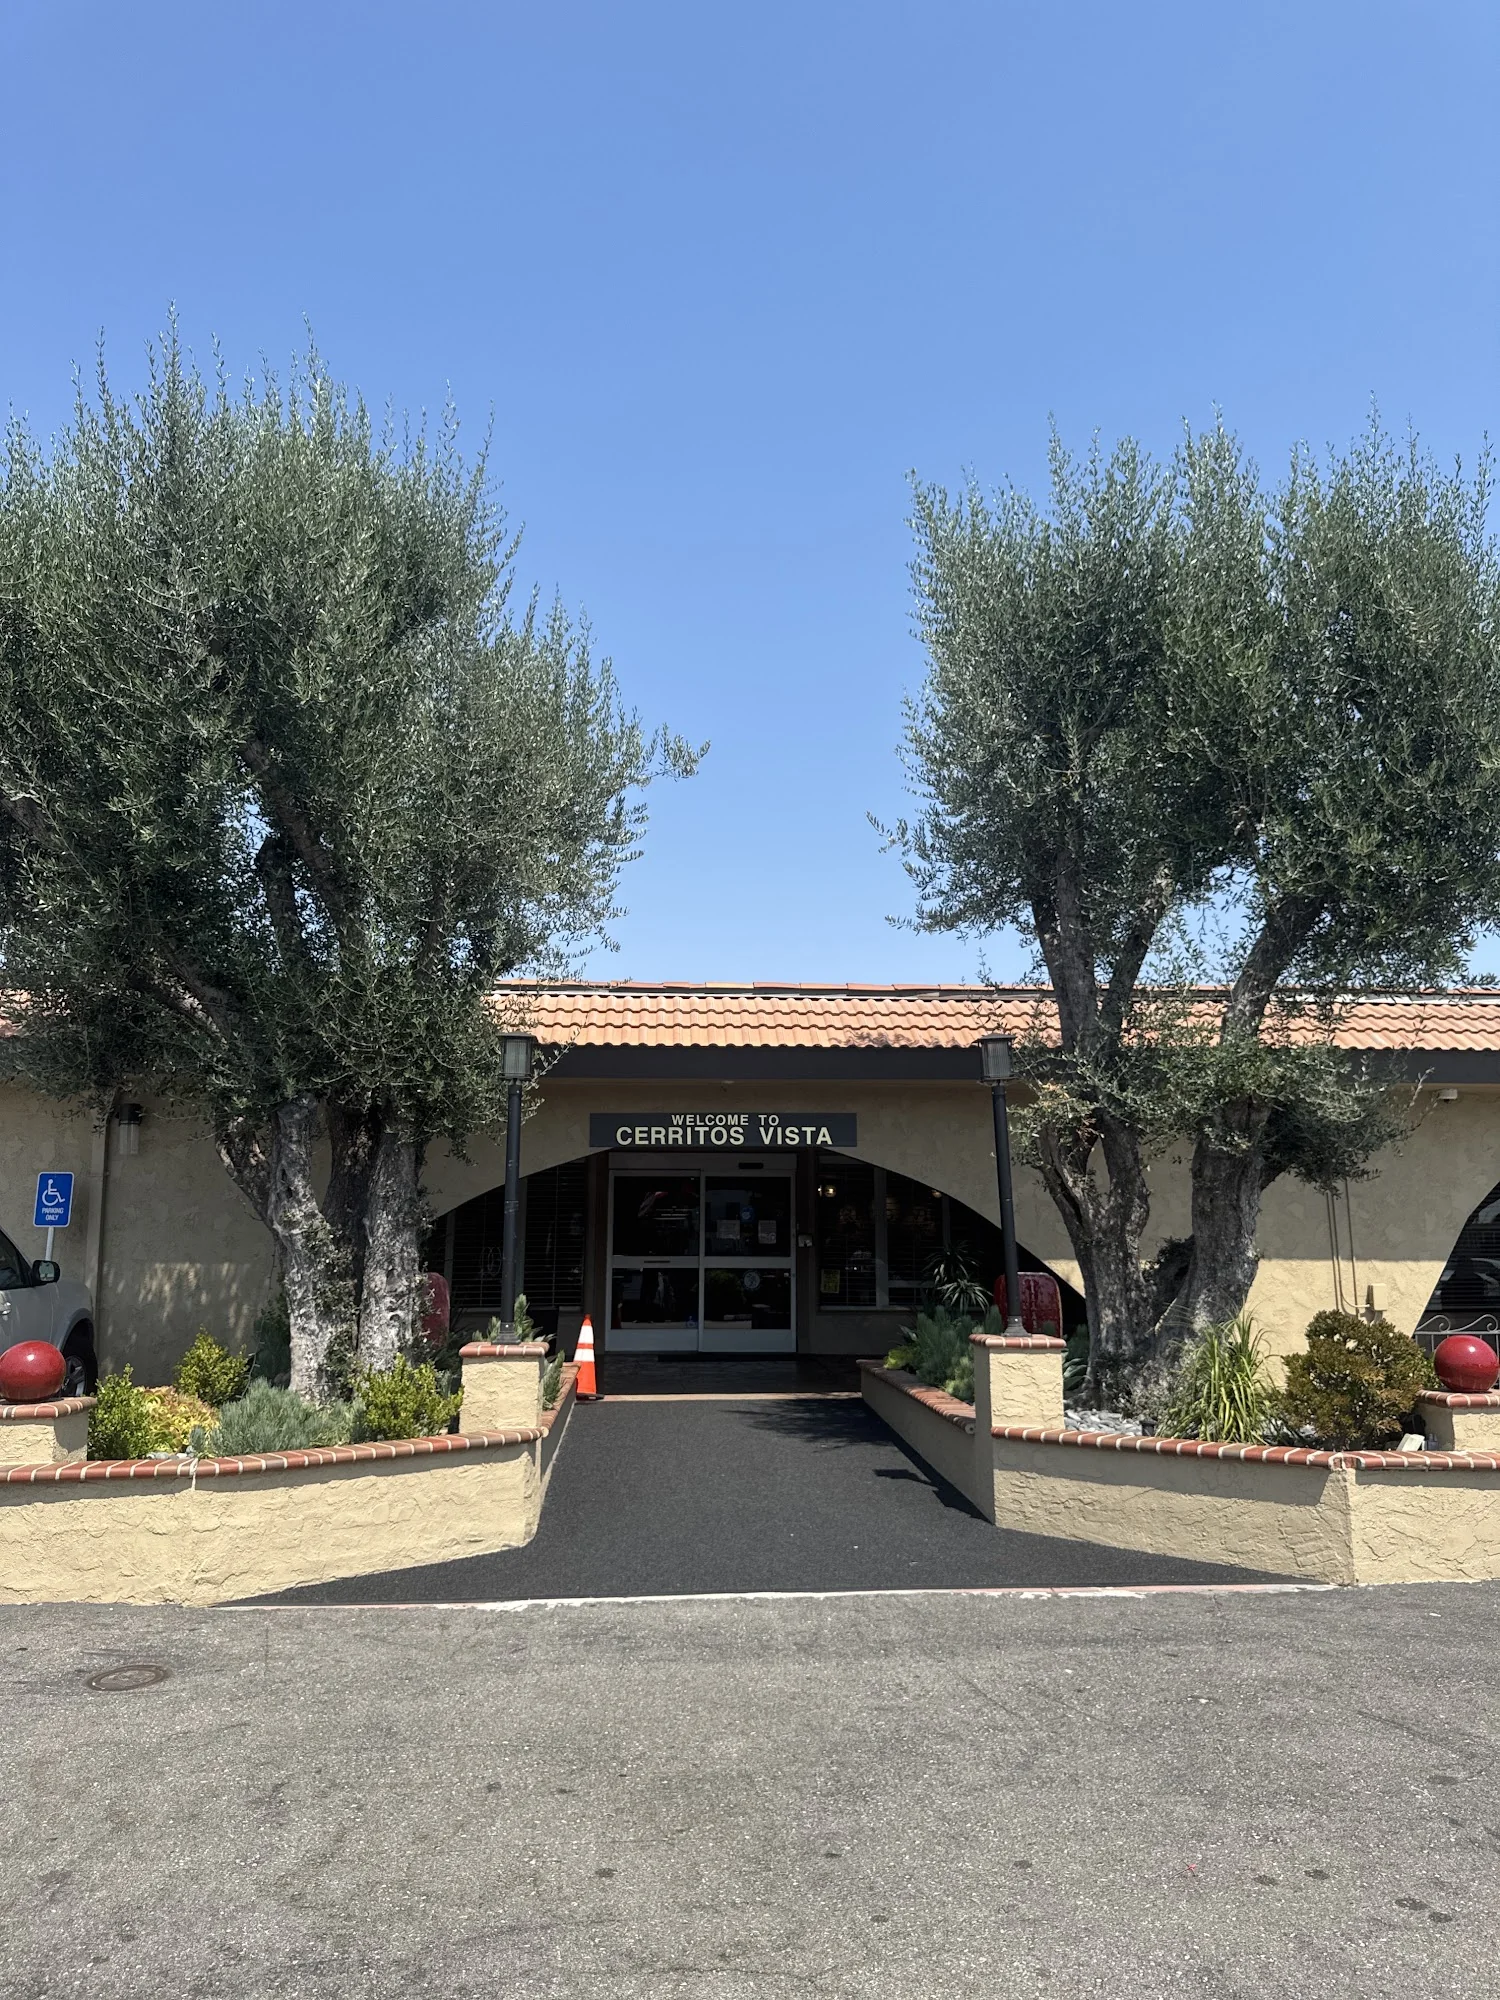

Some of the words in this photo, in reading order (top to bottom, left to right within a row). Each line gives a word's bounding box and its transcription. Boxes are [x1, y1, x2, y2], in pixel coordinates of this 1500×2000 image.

[671, 1114, 749, 1126] WELCOME
[758, 1114, 780, 1126] TO
[615, 1126, 745, 1145] CERRITOS
[758, 1126, 833, 1145] VISTA
